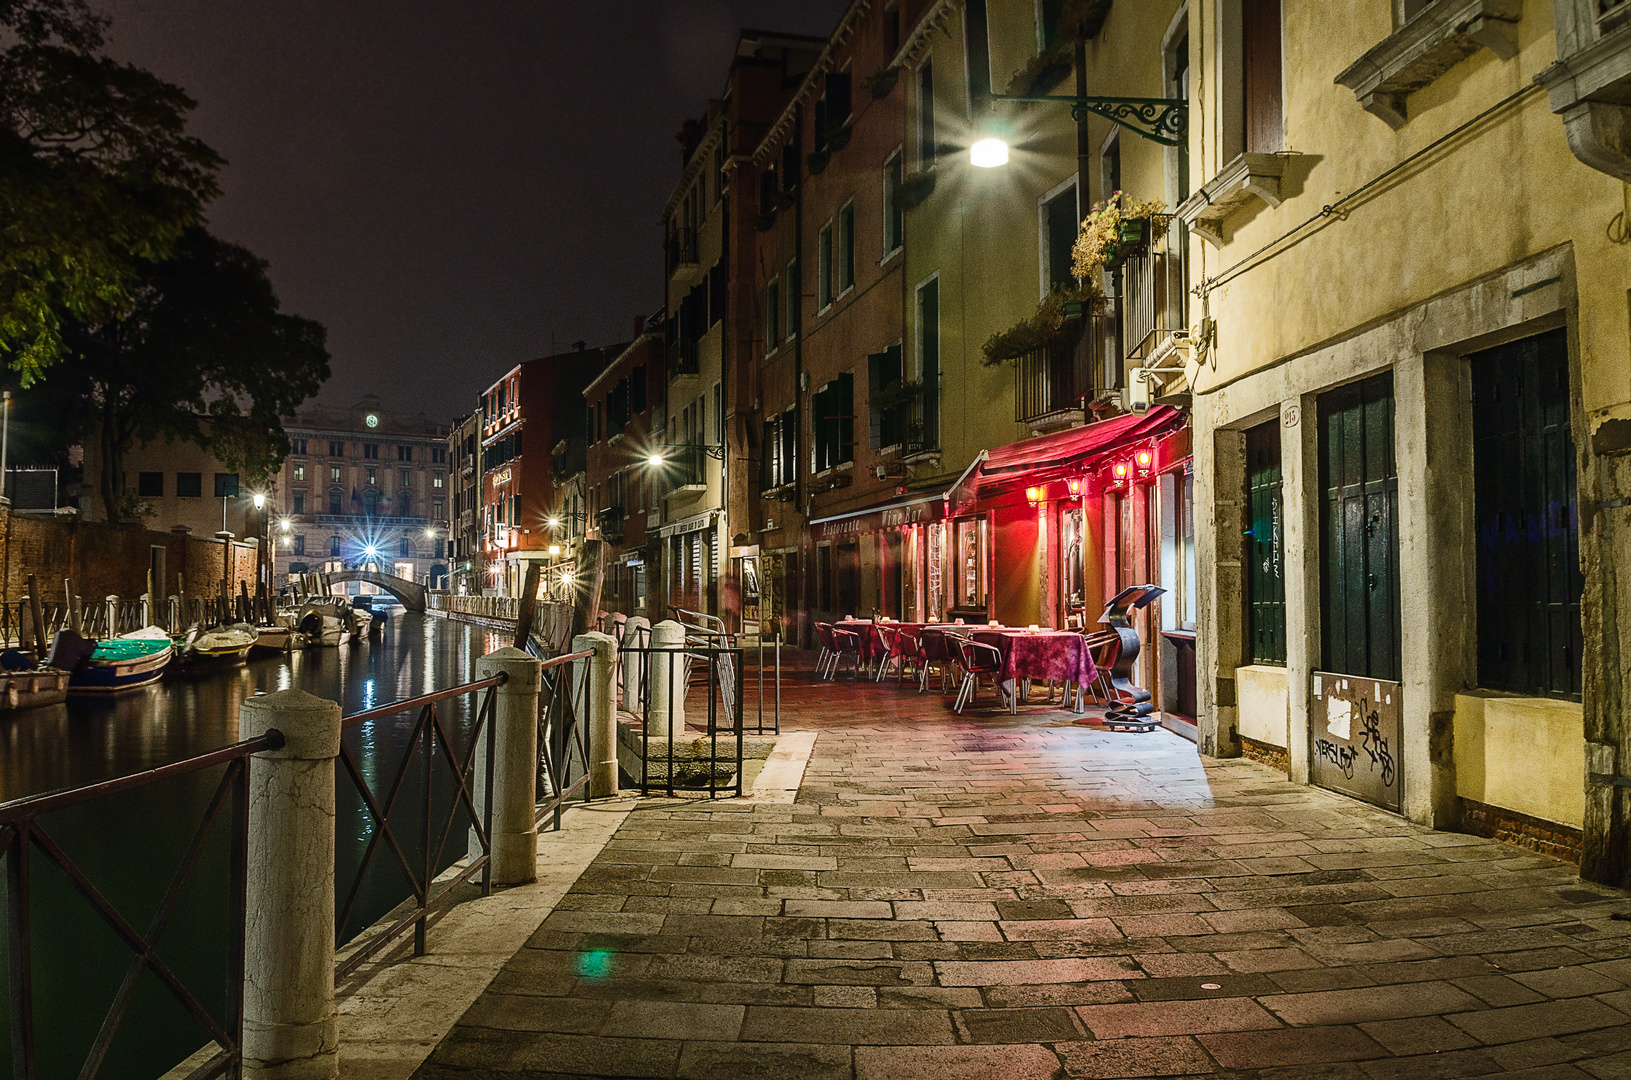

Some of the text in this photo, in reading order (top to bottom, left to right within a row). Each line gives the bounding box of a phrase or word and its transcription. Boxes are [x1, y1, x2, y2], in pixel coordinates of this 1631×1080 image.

[822, 506, 922, 536] Ristorante Wine Bar
